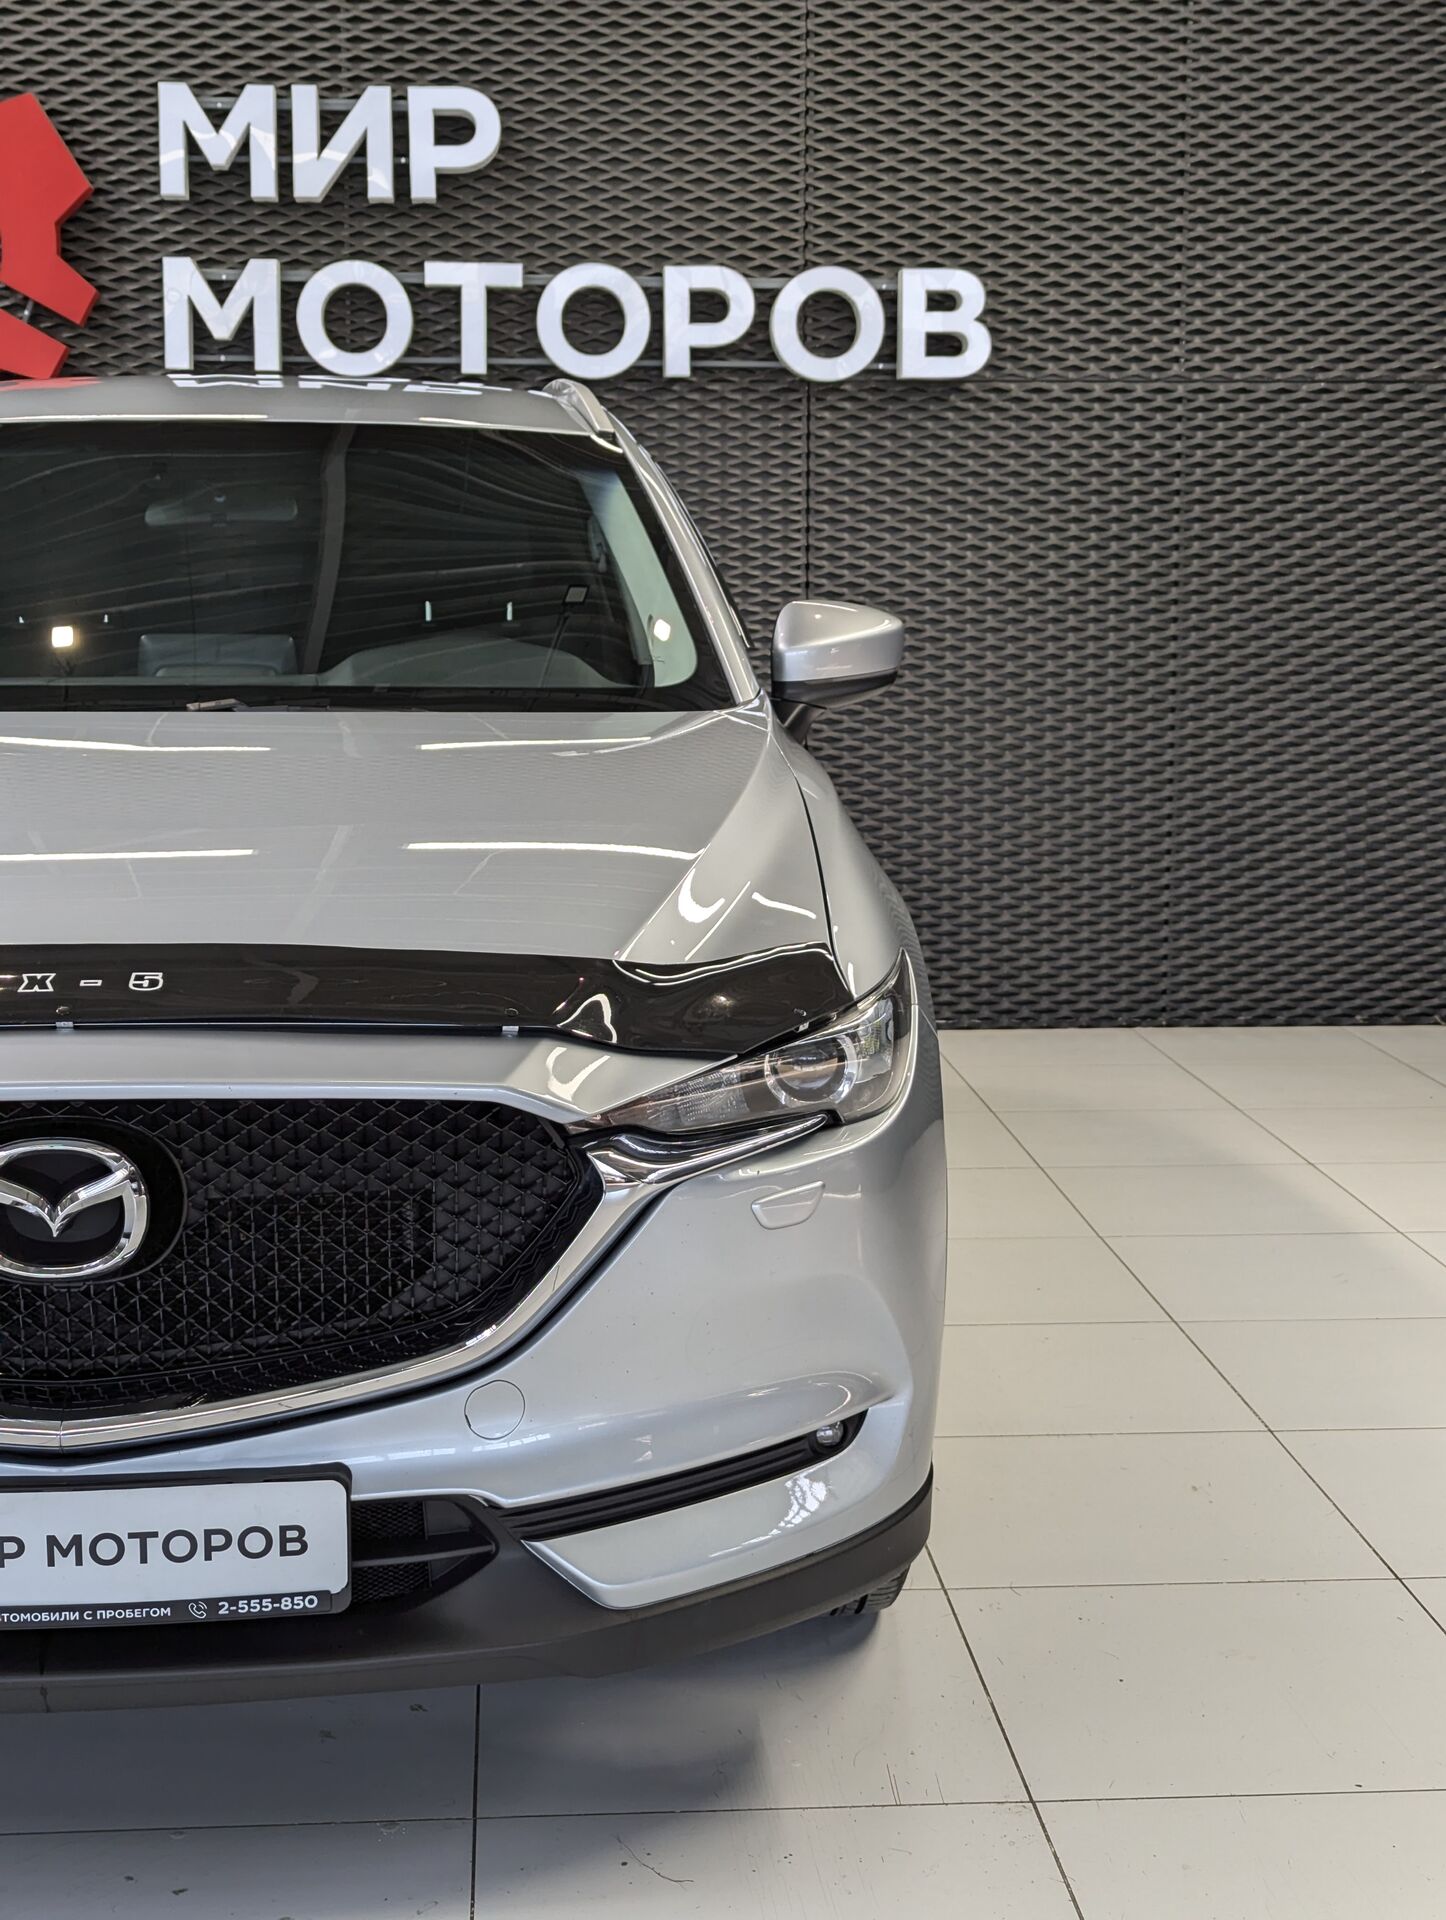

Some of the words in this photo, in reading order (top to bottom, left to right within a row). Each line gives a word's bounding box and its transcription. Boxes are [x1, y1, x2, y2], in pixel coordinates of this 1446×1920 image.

[157, 81, 502, 204] МИР
[161, 256, 993, 383] МОТОРОВ
[45, 1524, 310, 1568] МОТОРОВ
[0, 1611, 80, 1623] ТОМОБИЛИ
[83, 1610, 94, 1621] С
[96, 1606, 172, 1620] ПРОБЕГОМ
[217, 1594, 319, 1615] 2-555-850
